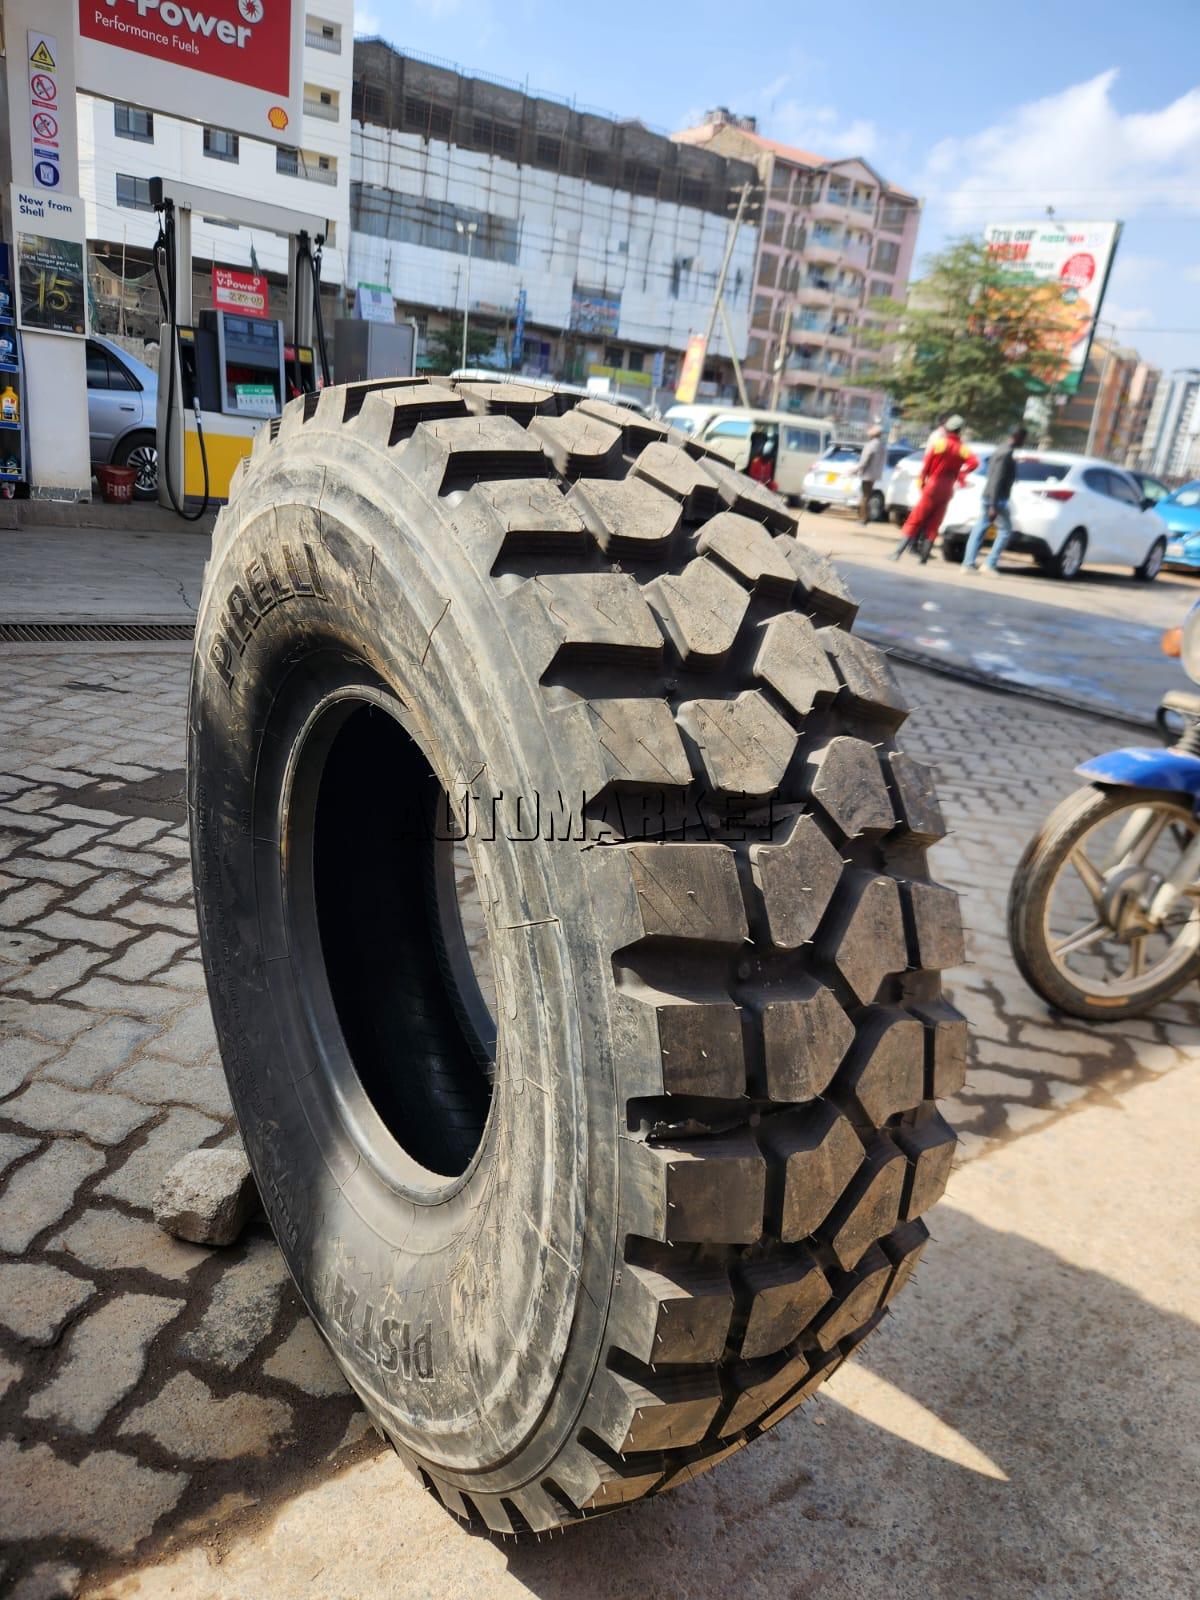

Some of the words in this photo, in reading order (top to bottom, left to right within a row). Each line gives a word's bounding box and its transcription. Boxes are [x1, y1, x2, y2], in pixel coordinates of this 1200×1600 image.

[95, 10, 169, 46] Performance
[172, 35, 200, 56] Fuels
[19, 193, 43, 207] New
[48, 199, 72, 213] from
[20, 205, 44, 218] Shell
[207, 542, 328, 690] PIRELLI
